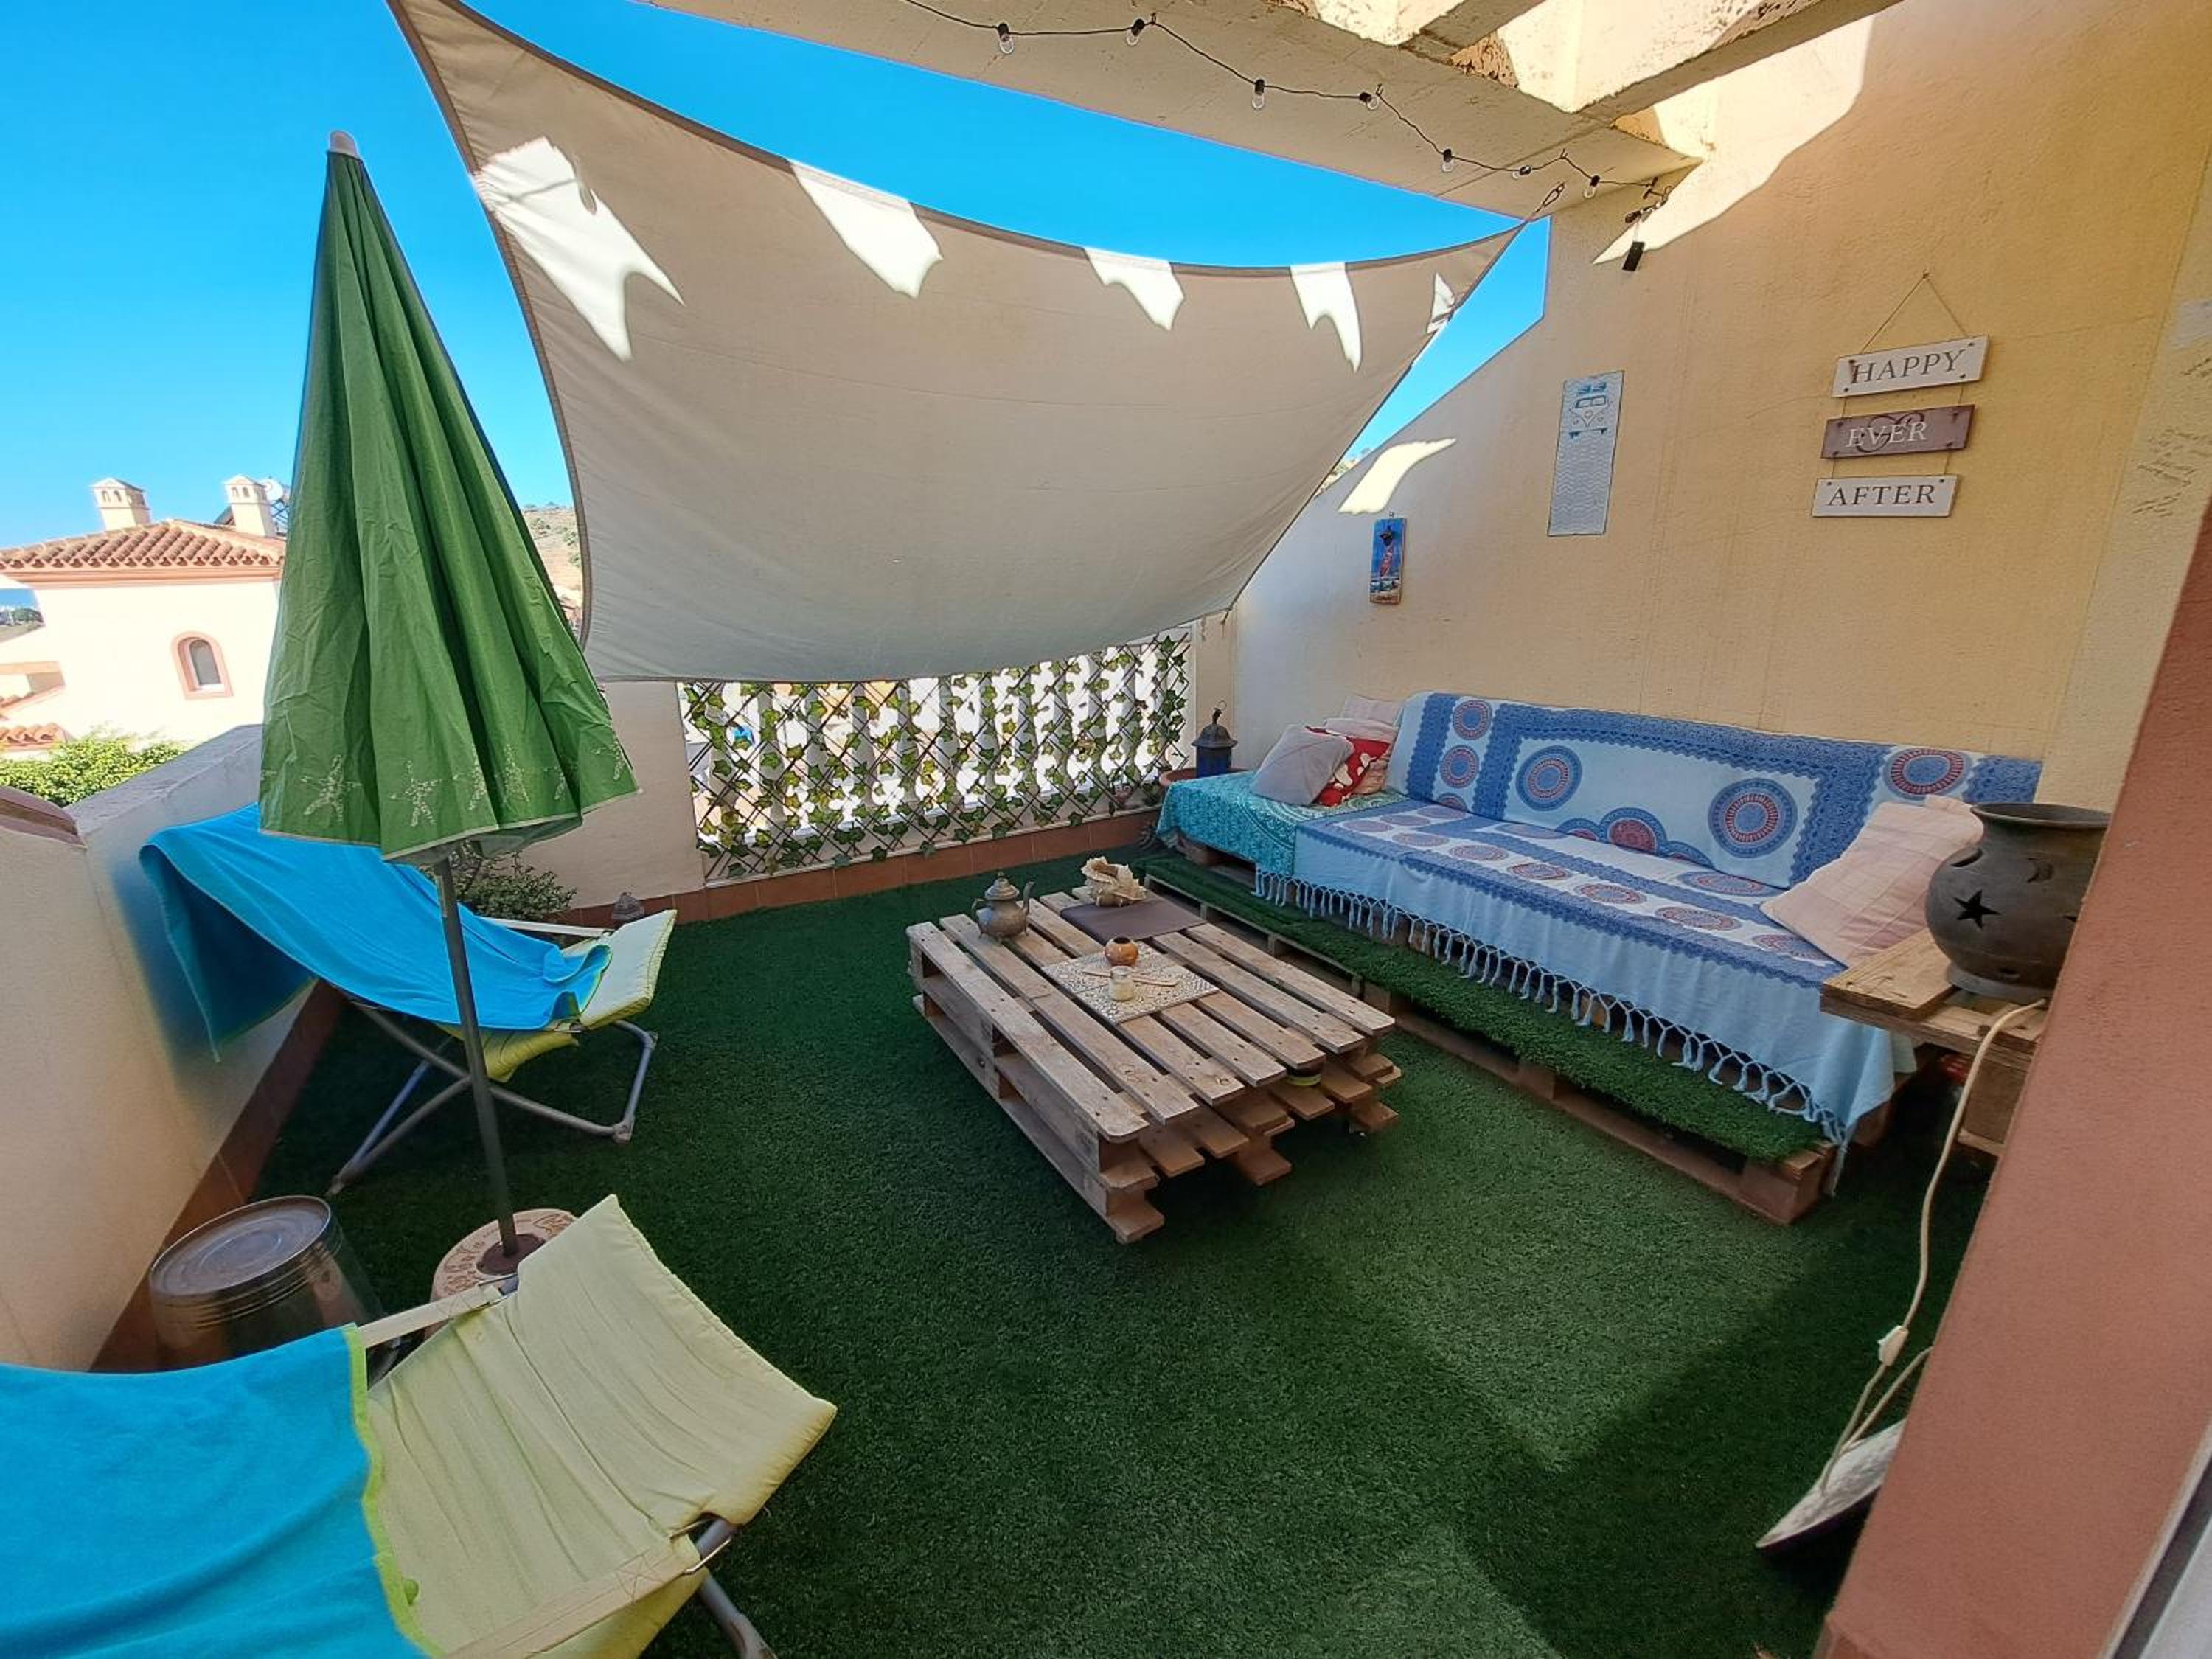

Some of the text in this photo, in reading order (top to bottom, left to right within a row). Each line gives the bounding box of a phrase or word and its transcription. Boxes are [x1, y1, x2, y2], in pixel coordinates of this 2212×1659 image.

[1850, 349, 1966, 384] HAPPY
[1846, 421, 1928, 448] EVER
[1826, 484, 1935, 507] AFTER
